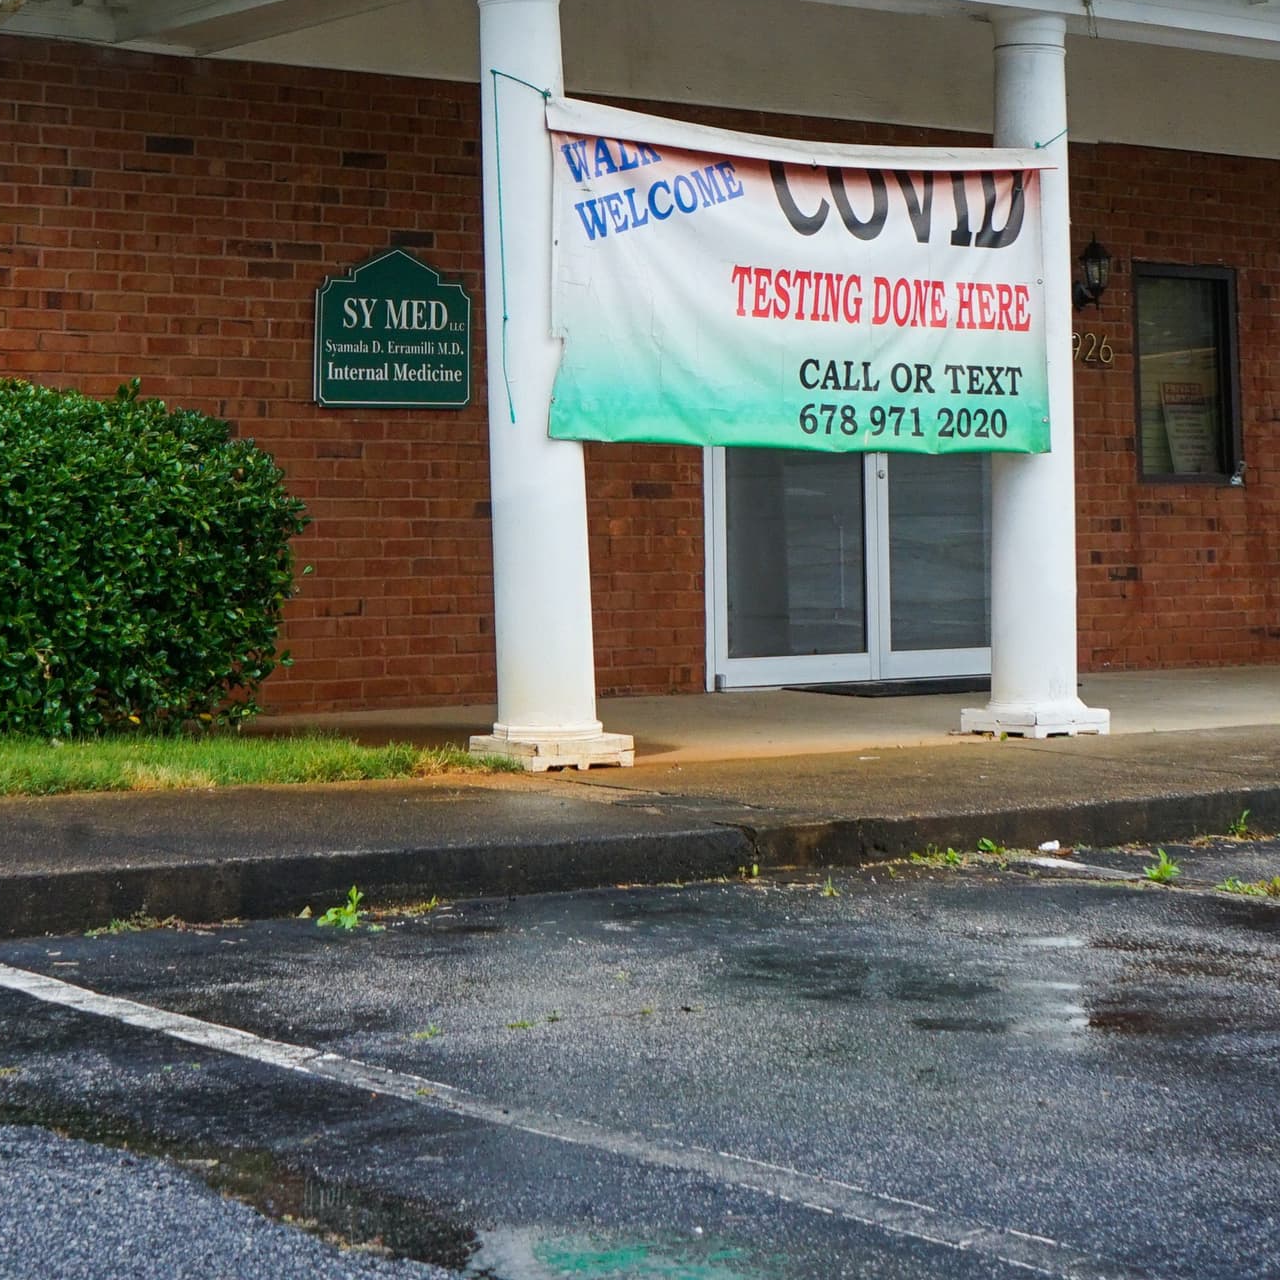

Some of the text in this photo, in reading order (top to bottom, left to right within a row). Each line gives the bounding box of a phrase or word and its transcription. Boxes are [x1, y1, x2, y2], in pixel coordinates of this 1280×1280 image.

[574, 161, 744, 240] WELCOME
[769, 160, 1025, 248] COVID
[343, 297, 464, 331] SY MED LLC
[731, 265, 1032, 332] TESTING DONE HERE
[325, 338, 464, 357] Syamala D. Erramilli M.D.
[327, 361, 463, 382] Internal Medicine
[799, 359, 1023, 397] CALL OR TEXT
[799, 403, 1008, 439] 678 971 2020
